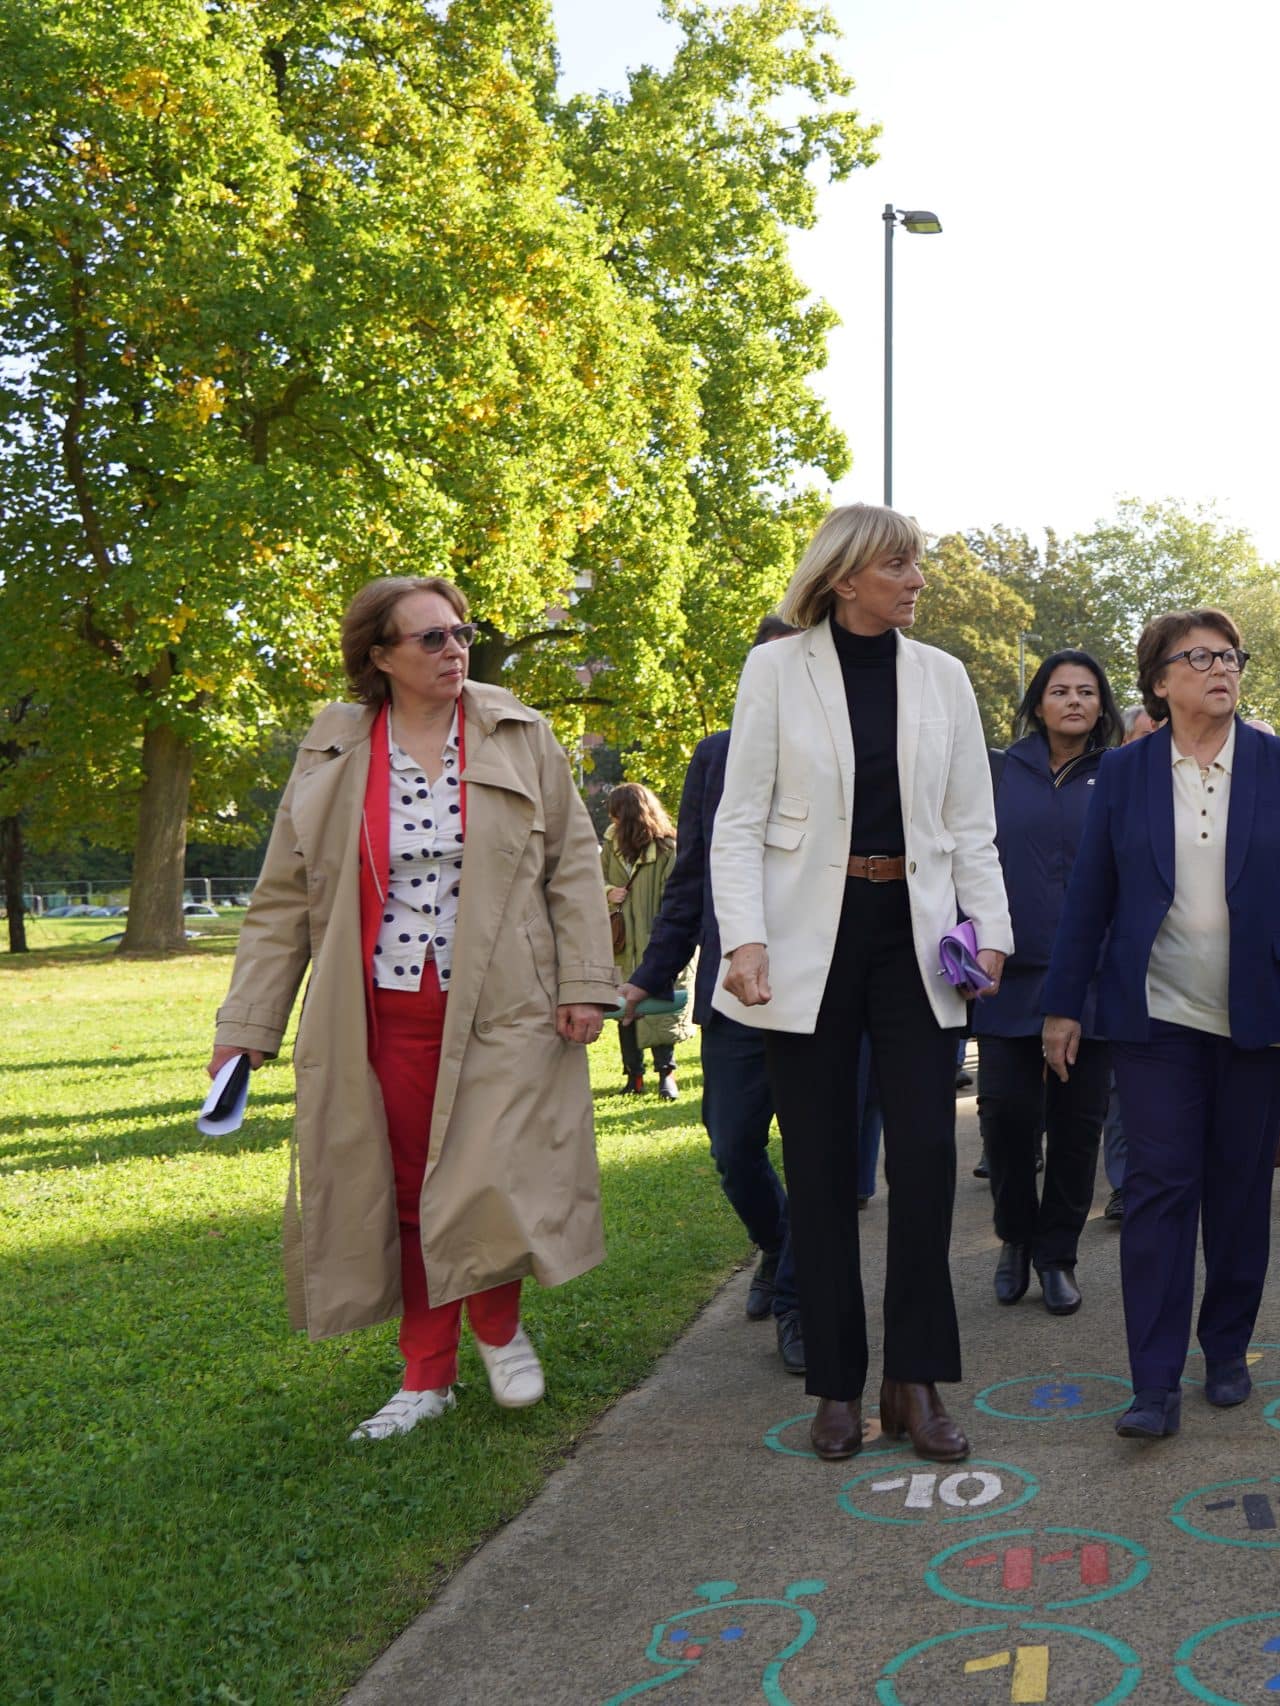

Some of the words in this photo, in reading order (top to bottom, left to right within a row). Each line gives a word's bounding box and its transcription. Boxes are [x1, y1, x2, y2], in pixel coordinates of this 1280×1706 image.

[1029, 1382, 1085, 1410] 8
[871, 1471, 1004, 1508] 10
[964, 1544, 1109, 1590] 11
[964, 1645, 1050, 1703] 1
